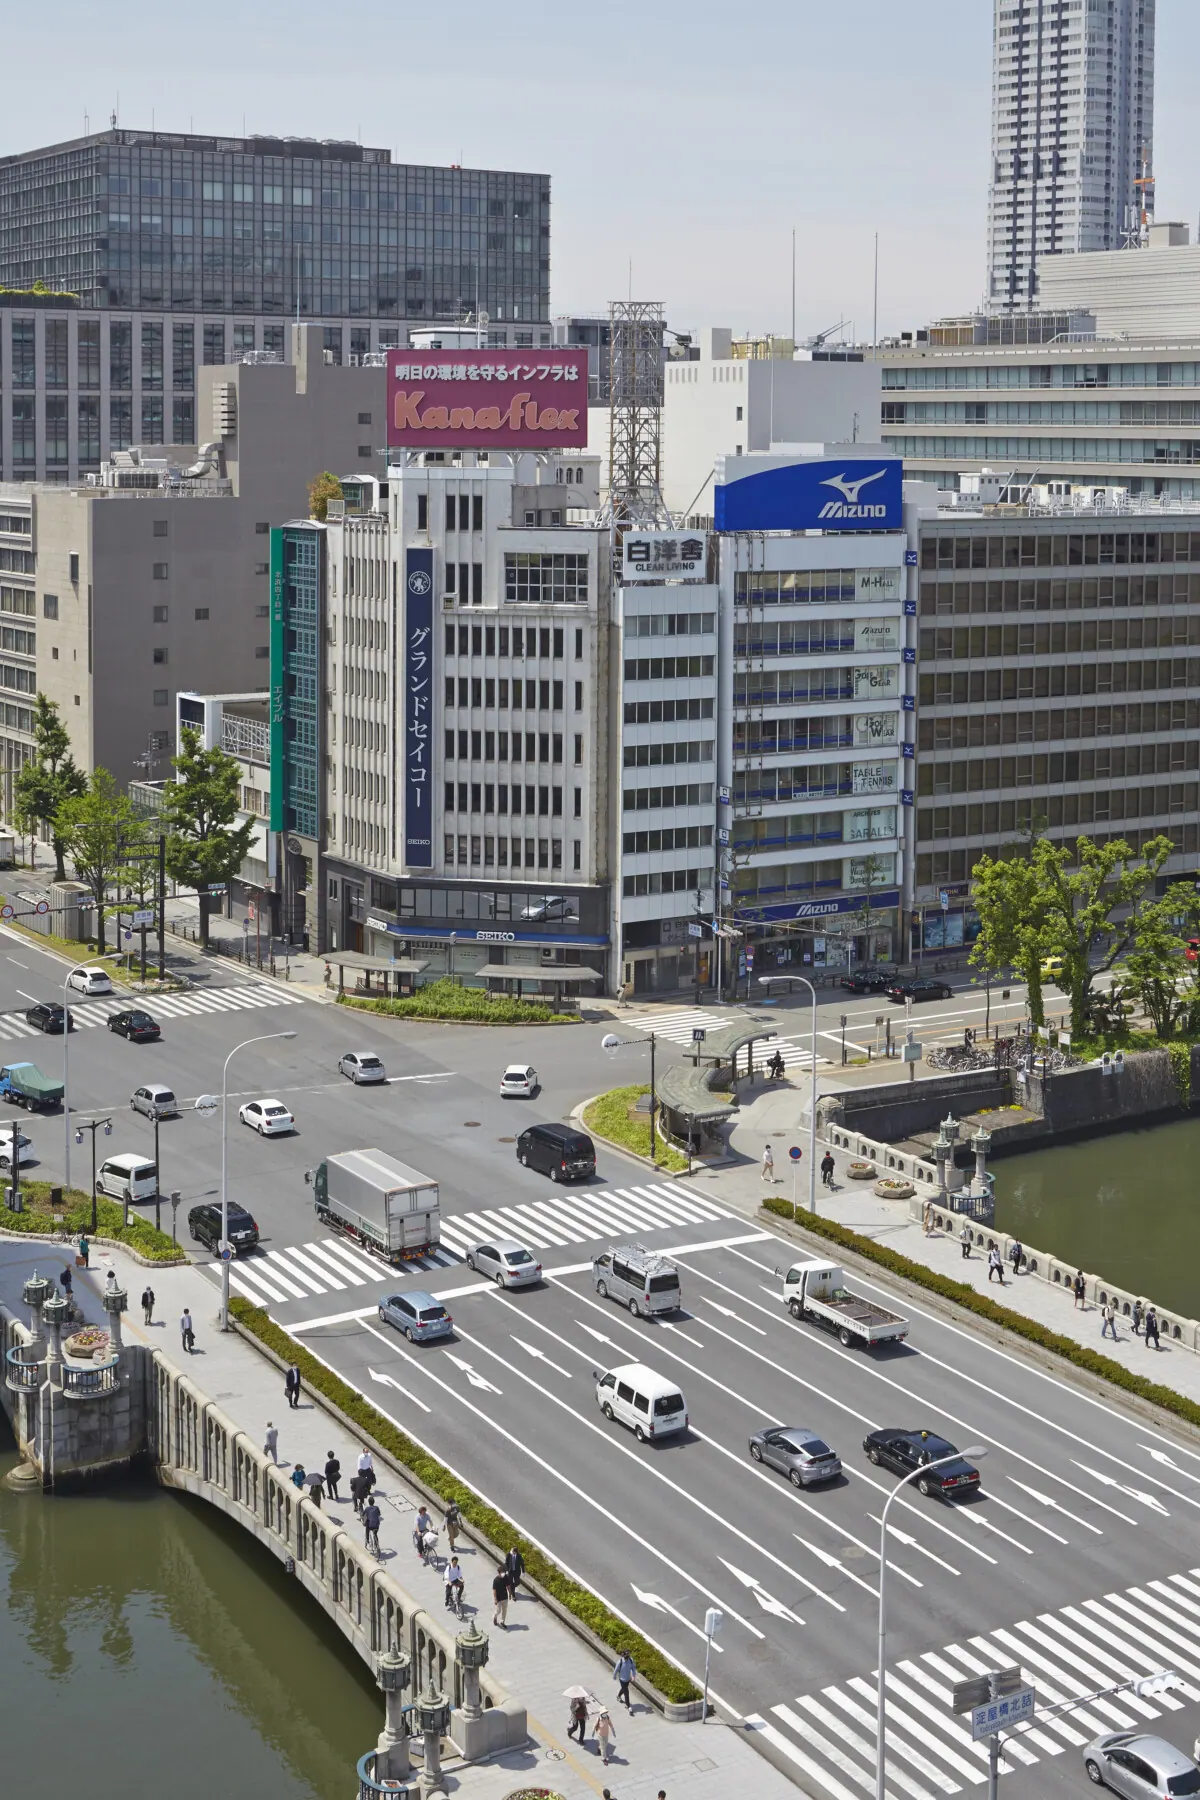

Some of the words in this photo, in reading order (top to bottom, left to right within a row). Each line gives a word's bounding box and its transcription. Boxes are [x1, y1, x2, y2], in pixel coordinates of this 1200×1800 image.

[395, 364, 579, 381] 明日の環境を守るインフラは
[394, 391, 579, 430] Kanaflex
[635, 563, 664, 571] CLEAN
[667, 562, 695, 571] LIVING
[408, 627, 431, 807] グランドセイコー
[476, 931, 515, 941] SEIKO
[976, 1694, 1032, 1726] 淀屋橋北詰
